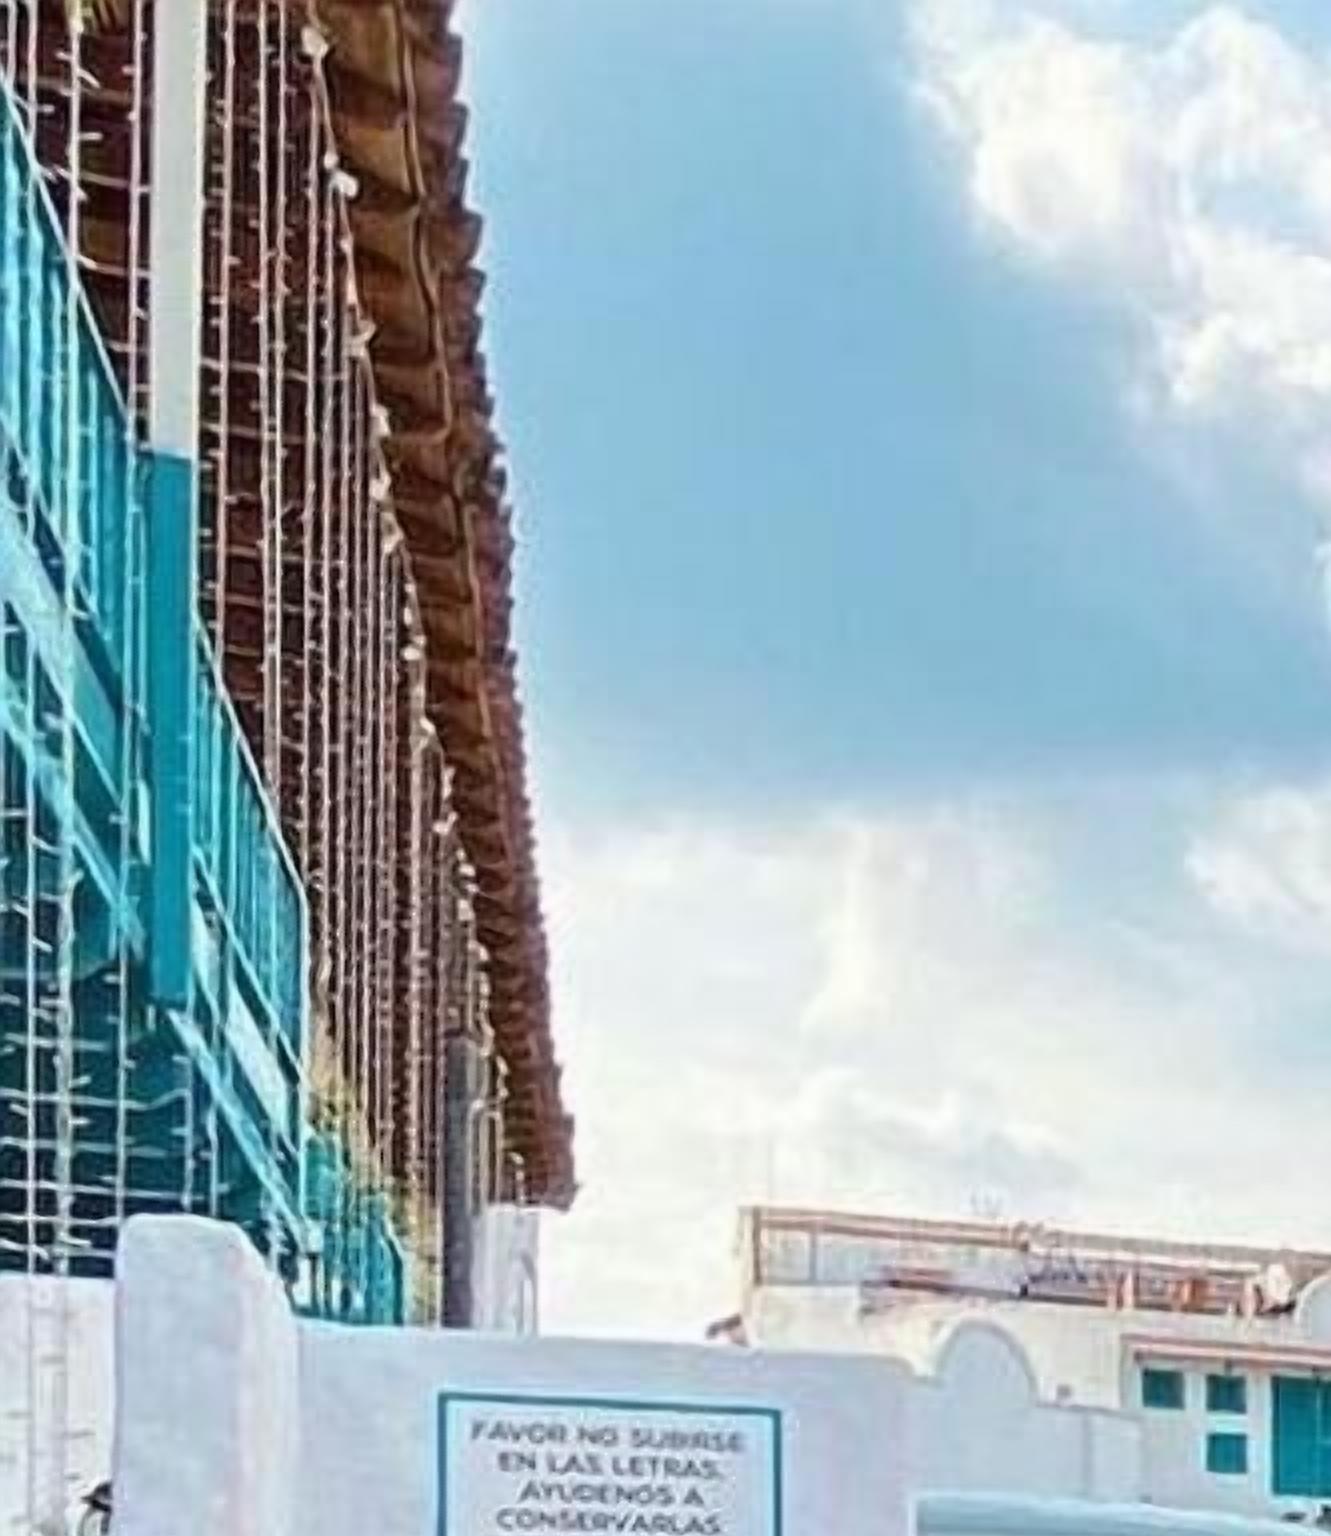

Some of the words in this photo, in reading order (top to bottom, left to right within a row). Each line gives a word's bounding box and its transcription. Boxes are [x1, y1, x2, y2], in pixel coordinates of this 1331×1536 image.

[471, 1419, 567, 1444] FAVOR
[576, 1425, 619, 1447] NO
[631, 1428, 746, 1452] SUBIRSE
[498, 1451, 536, 1472] EN
[546, 1453, 603, 1476] LAS
[684, 1487, 705, 1505] A
[496, 1507, 721, 1536] CONSERVARLAS
